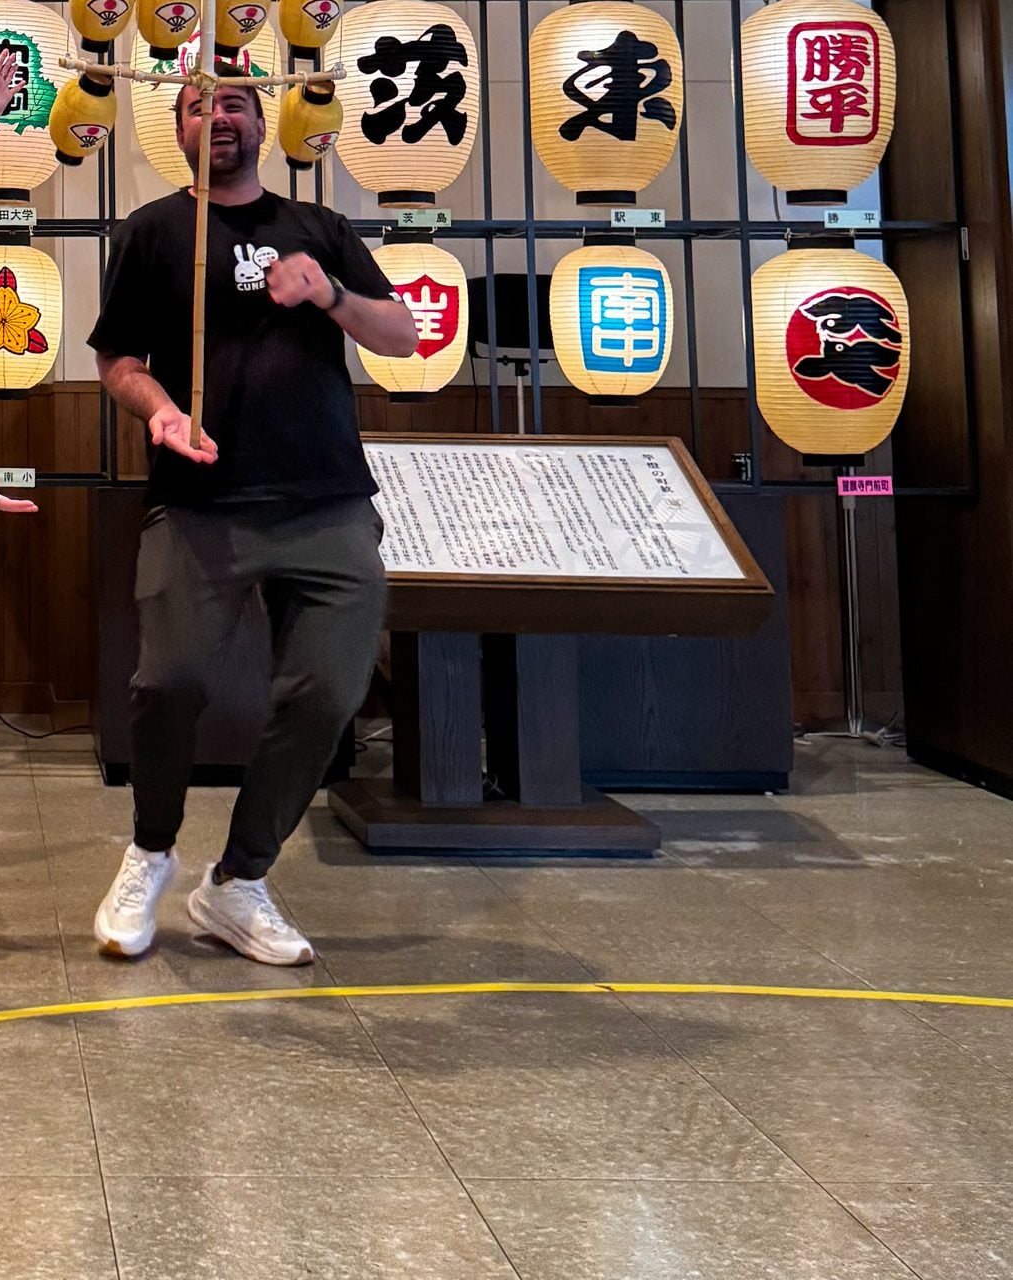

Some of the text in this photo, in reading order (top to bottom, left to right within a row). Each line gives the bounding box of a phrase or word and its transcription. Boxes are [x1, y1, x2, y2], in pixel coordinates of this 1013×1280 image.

[358, 24, 468, 146] 茨
[558, 30, 677, 141] 東
[802, 33, 870, 133] 勝平
[402, 213, 447, 223] 茨島
[614, 212, 661, 223] 駅東
[828, 213, 876, 224] 勝平
[236, 281, 266, 292] CUNE
[589, 272, 661, 368] 南中
